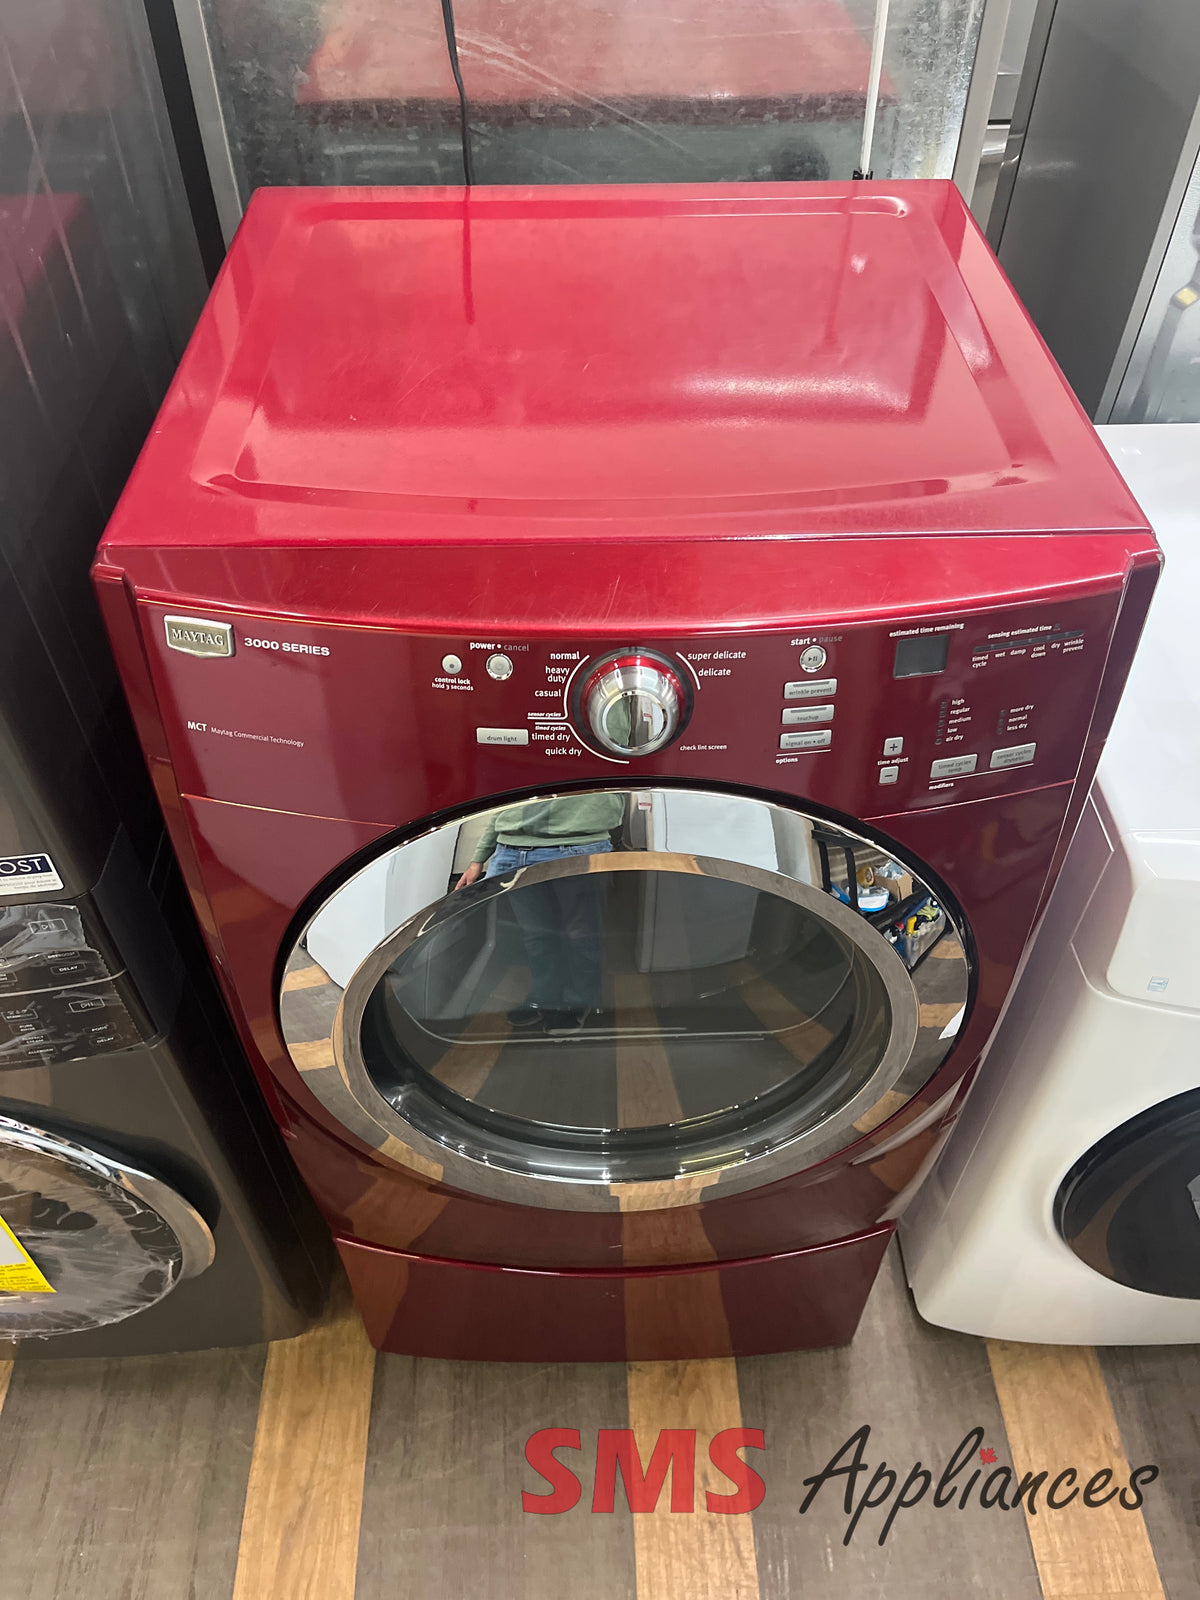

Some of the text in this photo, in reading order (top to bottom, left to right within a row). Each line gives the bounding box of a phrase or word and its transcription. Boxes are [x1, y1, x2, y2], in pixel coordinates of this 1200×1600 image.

[889, 628, 919, 637] estimated
[934, 623, 964, 632] remaining
[988, 631, 1010, 639] sensing
[1011, 626, 1039, 636] estimated
[172, 628, 224, 646] MAYTAG
[790, 635, 843, 646] start pause
[244, 637, 330, 656] 3000 SERIES
[470, 642, 495, 650] power
[1033, 644, 1045, 652] cool
[1062, 645, 1083, 653] prevent
[550, 651, 580, 660] normal
[687, 650, 746, 661] super delicate
[972, 654, 988, 662] timed
[972, 660, 987, 668] cycle
[545, 666, 570, 675] heavy
[698, 668, 732, 676] delicate
[547, 674, 566, 684] duty
[534, 689, 561, 697] casual
[810, 687, 832, 695] prevent
[952, 698, 965, 706] high
[950, 706, 970, 715] regular
[949, 716, 972, 724] medium
[1008, 714, 1027, 723] normal
[187, 721, 207, 732] MCT
[211, 727, 304, 748] Maytag Commercial Technology
[531, 733, 570, 742] timed dry
[545, 747, 582, 757] quick dry
[891, 757, 909, 765] adjust
